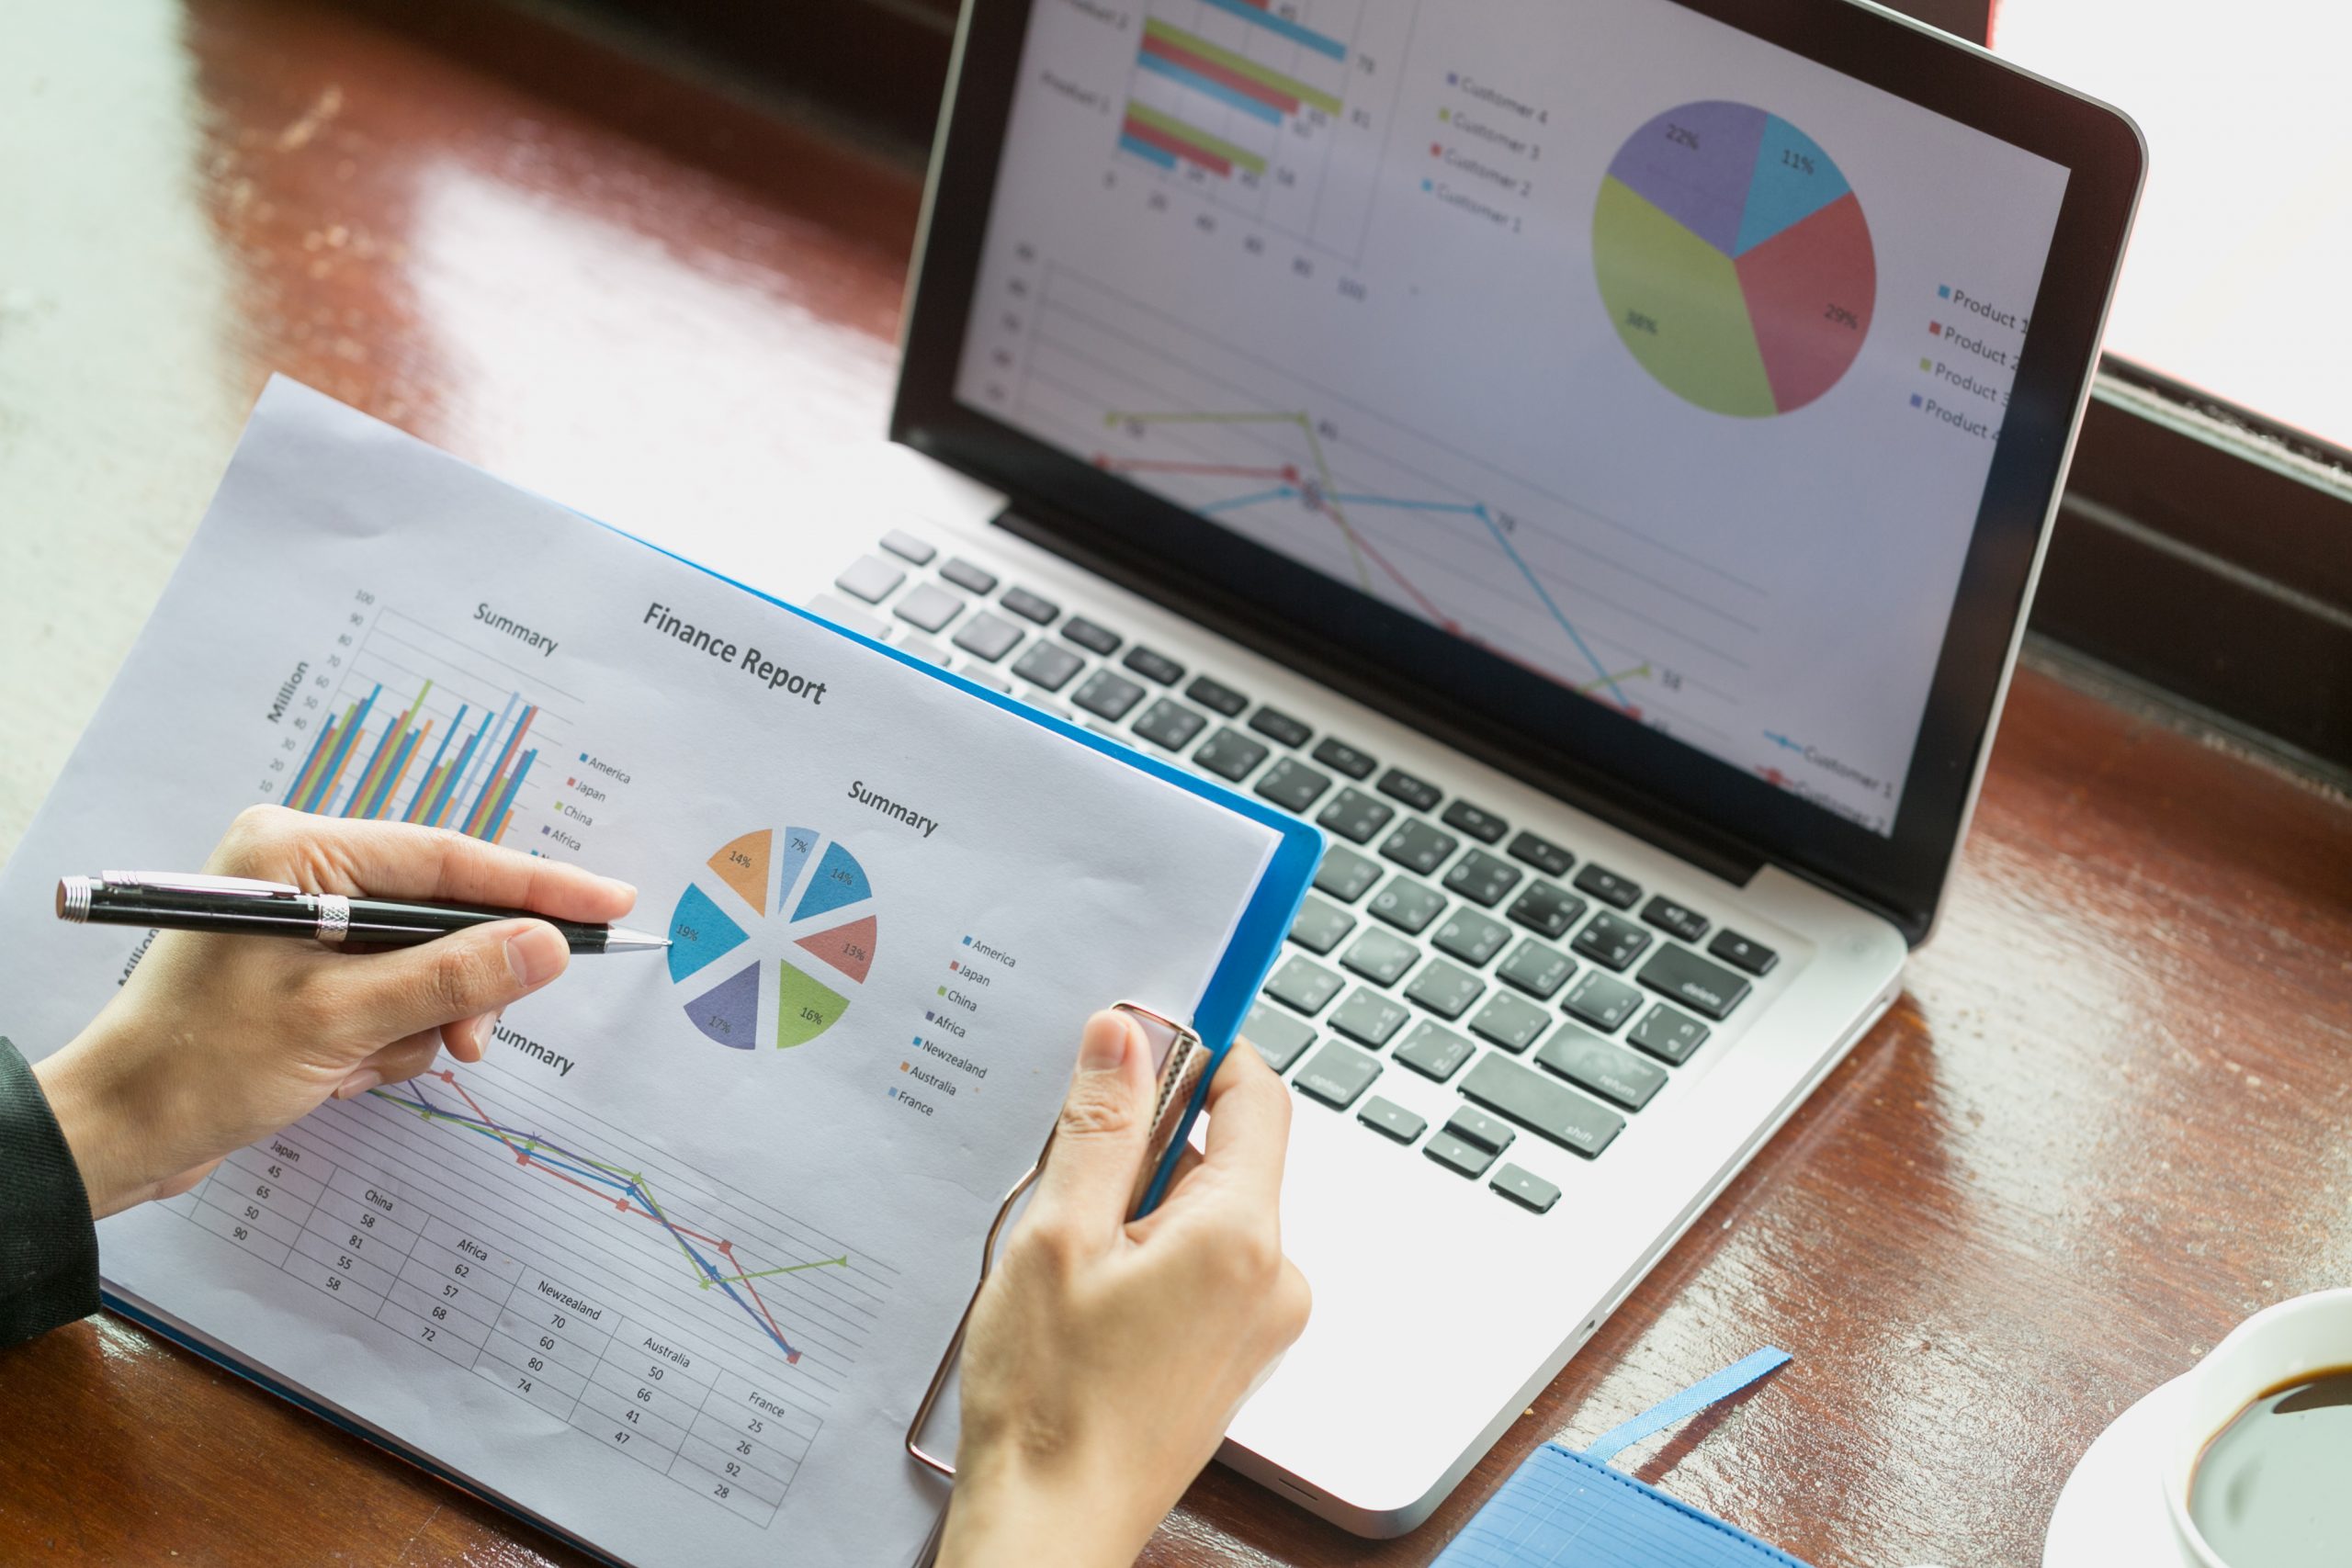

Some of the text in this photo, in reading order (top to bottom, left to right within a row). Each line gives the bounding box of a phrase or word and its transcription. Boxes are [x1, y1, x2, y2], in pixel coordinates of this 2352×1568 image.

[1665, 124, 1699, 151] 22%
[1781, 149, 1815, 175] 11%
[1823, 303, 1858, 330] 29%
[1952, 289, 2017, 329] Product
[1944, 326, 2007, 367] Product
[1935, 362, 1998, 403] Product
[1925, 399, 1988, 439] Product
[355, 589, 375, 605] 100
[472, 602, 560, 658] Summary
[327, 654, 341, 668] 70
[643, 602, 828, 705] Finance Report
[266, 660, 310, 724] Million
[270, 758, 285, 772] 20
[588, 757, 632, 784] America
[1804, 745, 1879, 791] Customer
[259, 779, 273, 793] 10
[574, 779, 607, 803] Japan
[563, 804, 594, 827] China
[847, 780, 939, 839] Summary
[551, 829, 582, 852] Africa
[790, 838, 808, 854] 7%
[728, 850, 752, 870] 14%
[830, 867, 854, 886] 14%
[675, 923, 700, 942] 19%
[842, 943, 866, 963] 13%
[971, 939, 1017, 968] America
[958, 964, 991, 988] Japan
[947, 989, 978, 1012] China
[1681, 982, 1722, 1007] delete
[708, 1015, 732, 1035] 17%
[799, 1007, 824, 1026] 16%
[933, 1014, 967, 1039] Africa
[922, 1040, 989, 1080] Newzealand
[910, 1066, 958, 1097] Australia
[1310, 1074, 1347, 1097] option
[1598, 1075, 1637, 1098] return
[898, 1090, 934, 1118] France
[1565, 1123, 1594, 1144] shift
[270, 1139, 786, 1418] Japan China Africa Newzealand Australia France
[266, 1165, 763, 1435] 45 58 62 70 50 25
[255, 1185, 752, 1456] 65 81 57 60 66 26
[243, 1205, 741, 1478] 50 55 68 80 41 92
[232, 1226, 730, 1500] 90 58 72 74 47 28
